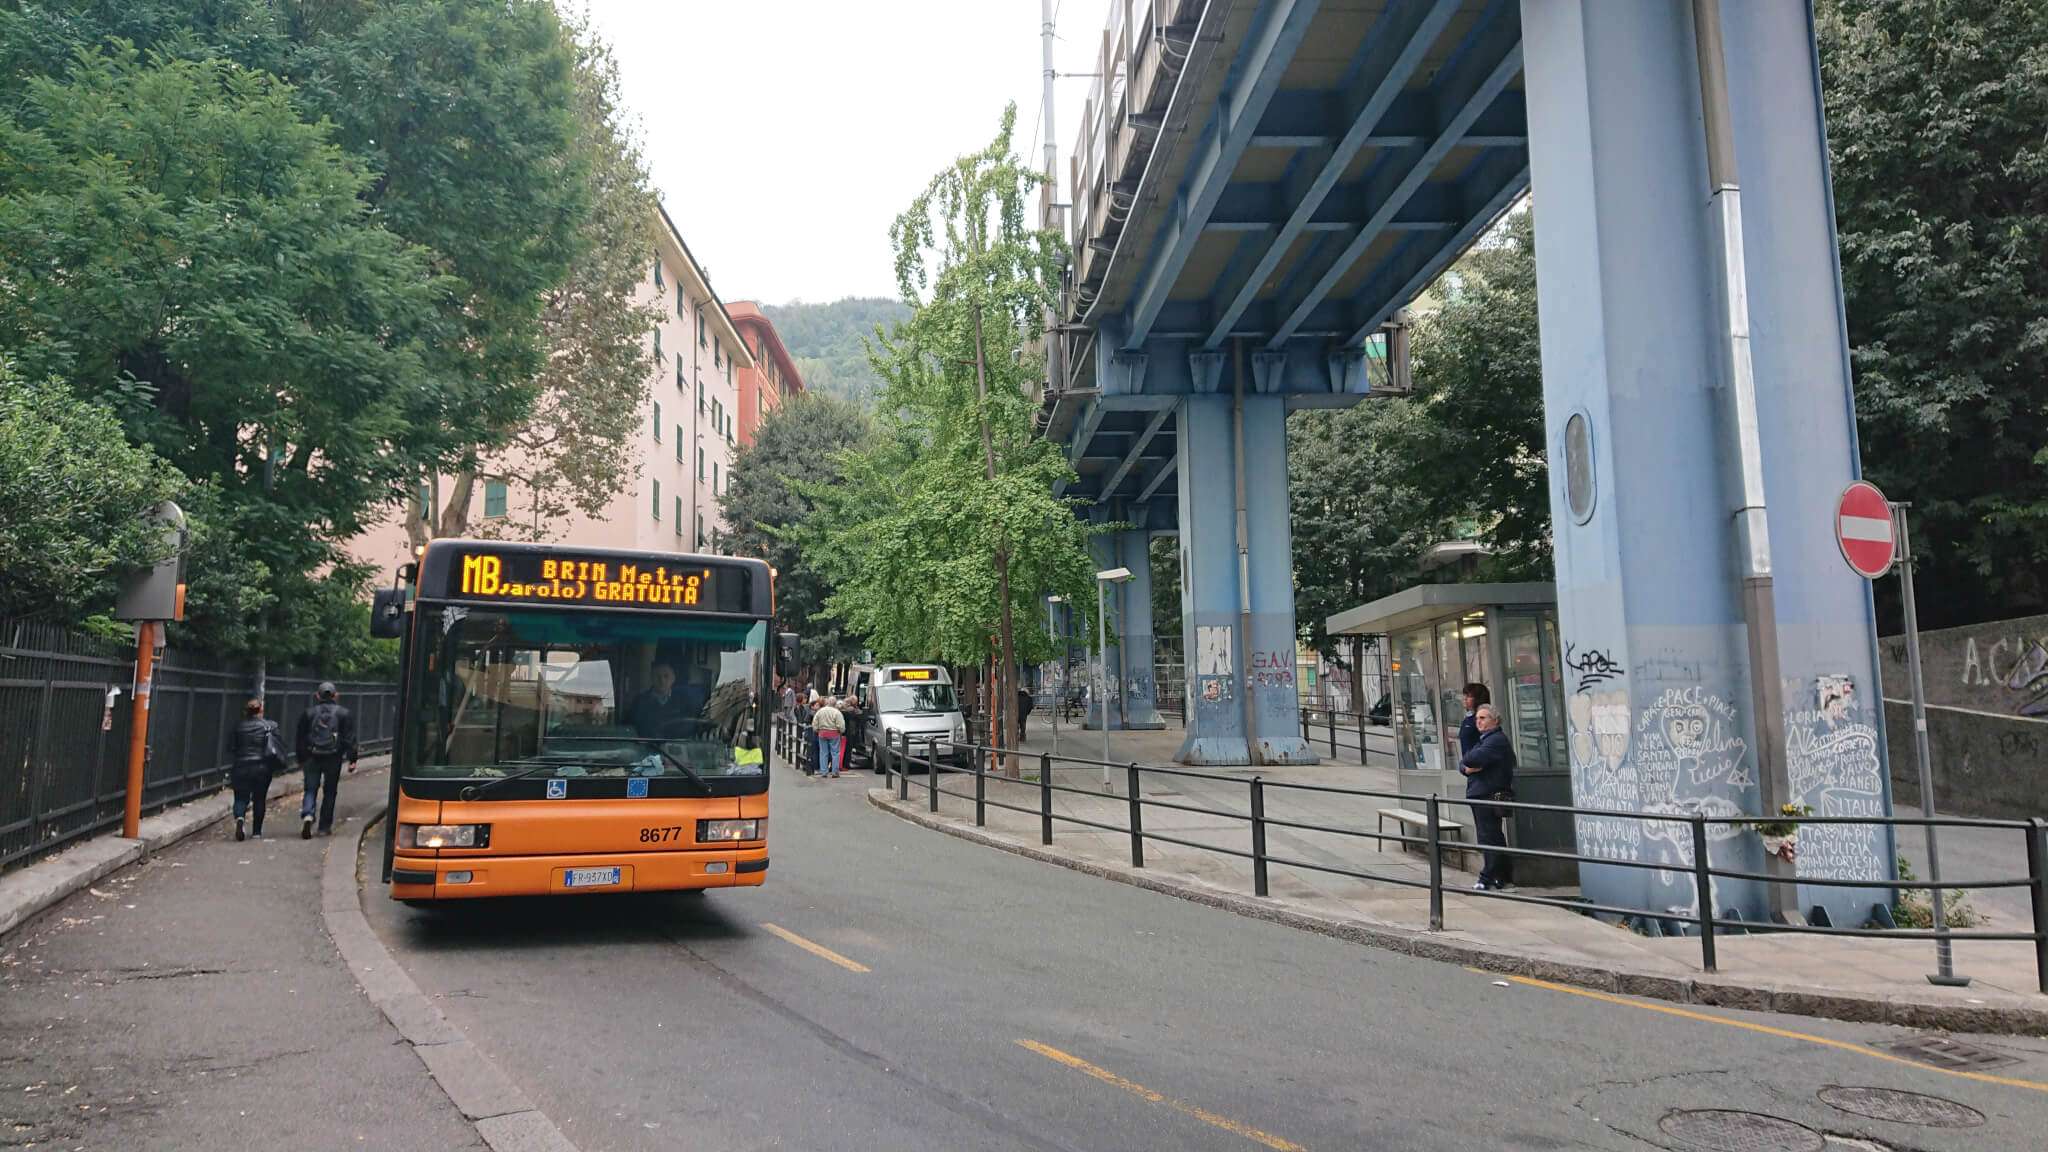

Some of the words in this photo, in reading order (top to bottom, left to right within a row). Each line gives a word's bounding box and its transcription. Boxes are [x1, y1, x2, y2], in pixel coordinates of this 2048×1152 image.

[462, 555, 500, 594] MB
[543, 560, 606, 581] BRIN
[639, 826, 682, 842] 8677
